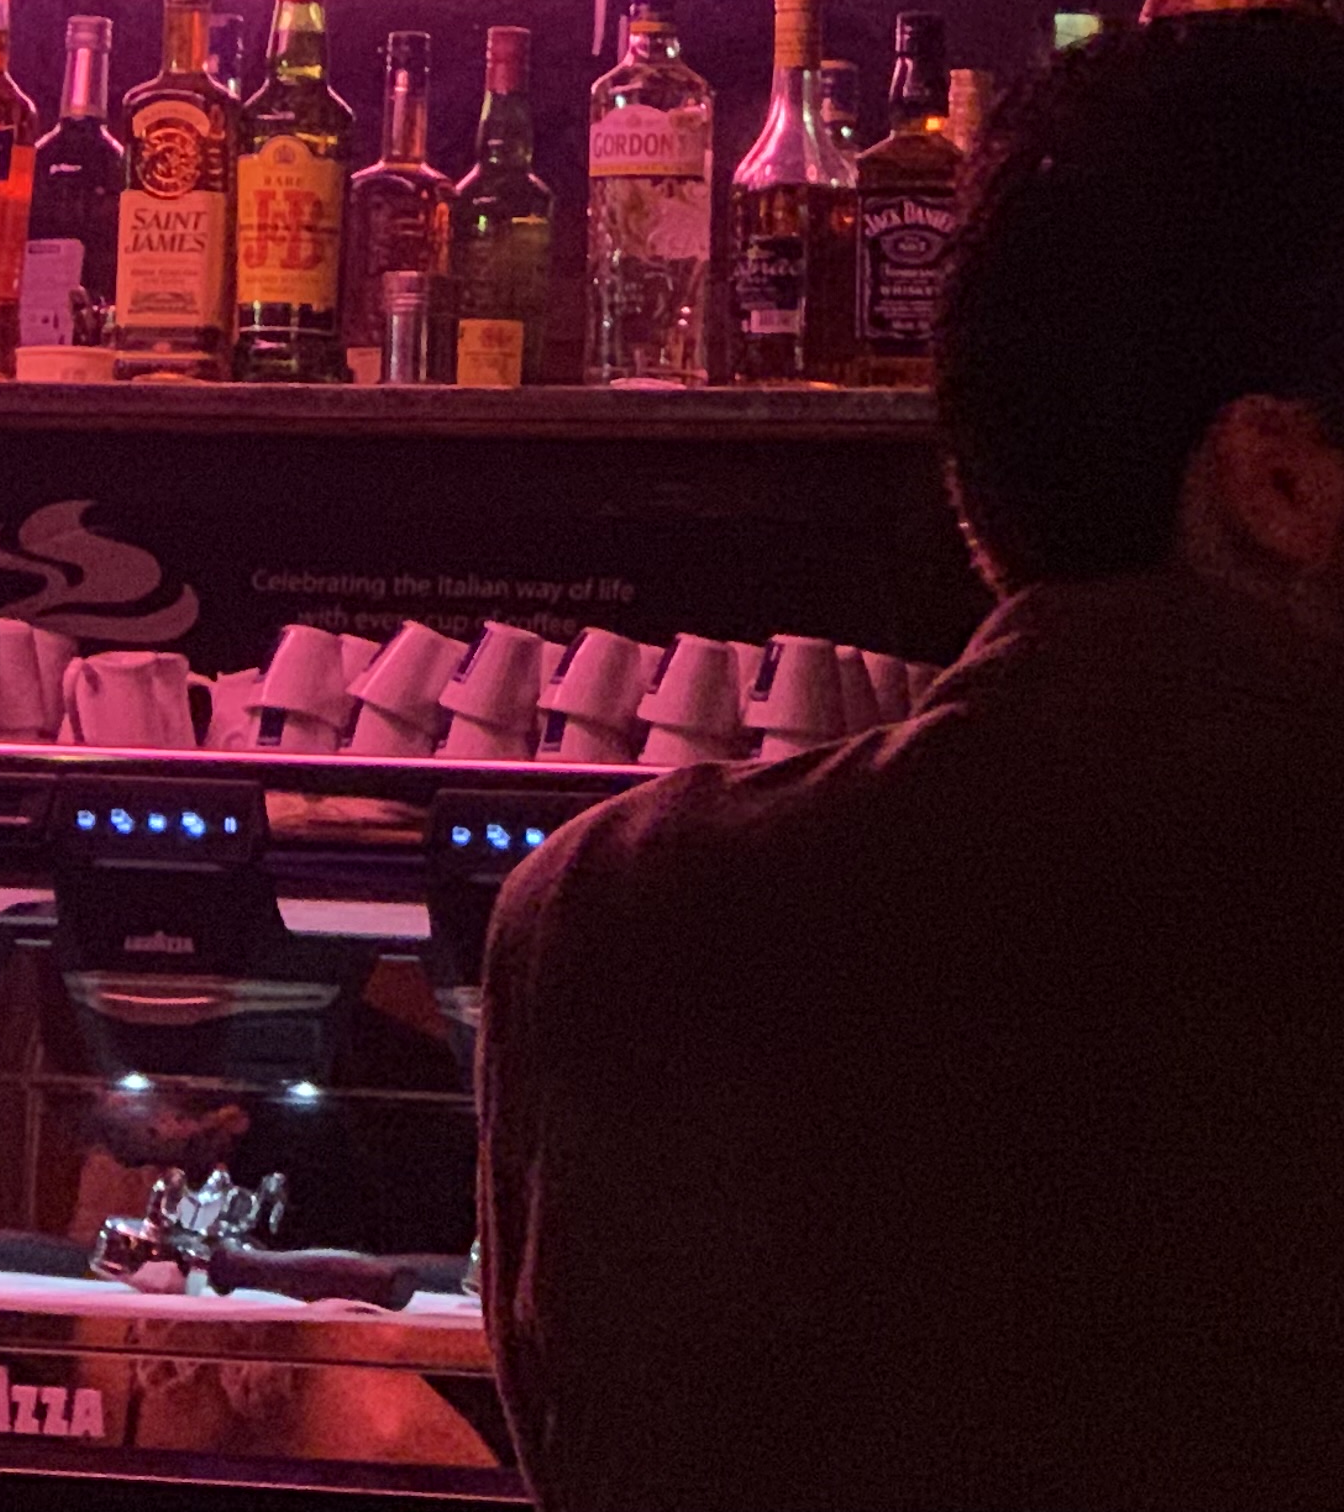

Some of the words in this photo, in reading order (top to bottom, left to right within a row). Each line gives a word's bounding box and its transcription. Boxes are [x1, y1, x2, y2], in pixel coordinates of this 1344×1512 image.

[130, 207, 207, 232] SAINT
[863, 207, 902, 237] JACK
[124, 232, 206, 254] JAMES
[252, 569, 387, 600] Celebrating
[392, 573, 432, 597] the
[436, 573, 510, 599] Italian
[516, 581, 565, 606] way
[568, 576, 594, 601] of
[598, 578, 636, 605] life
[297, 603, 350, 628] with
